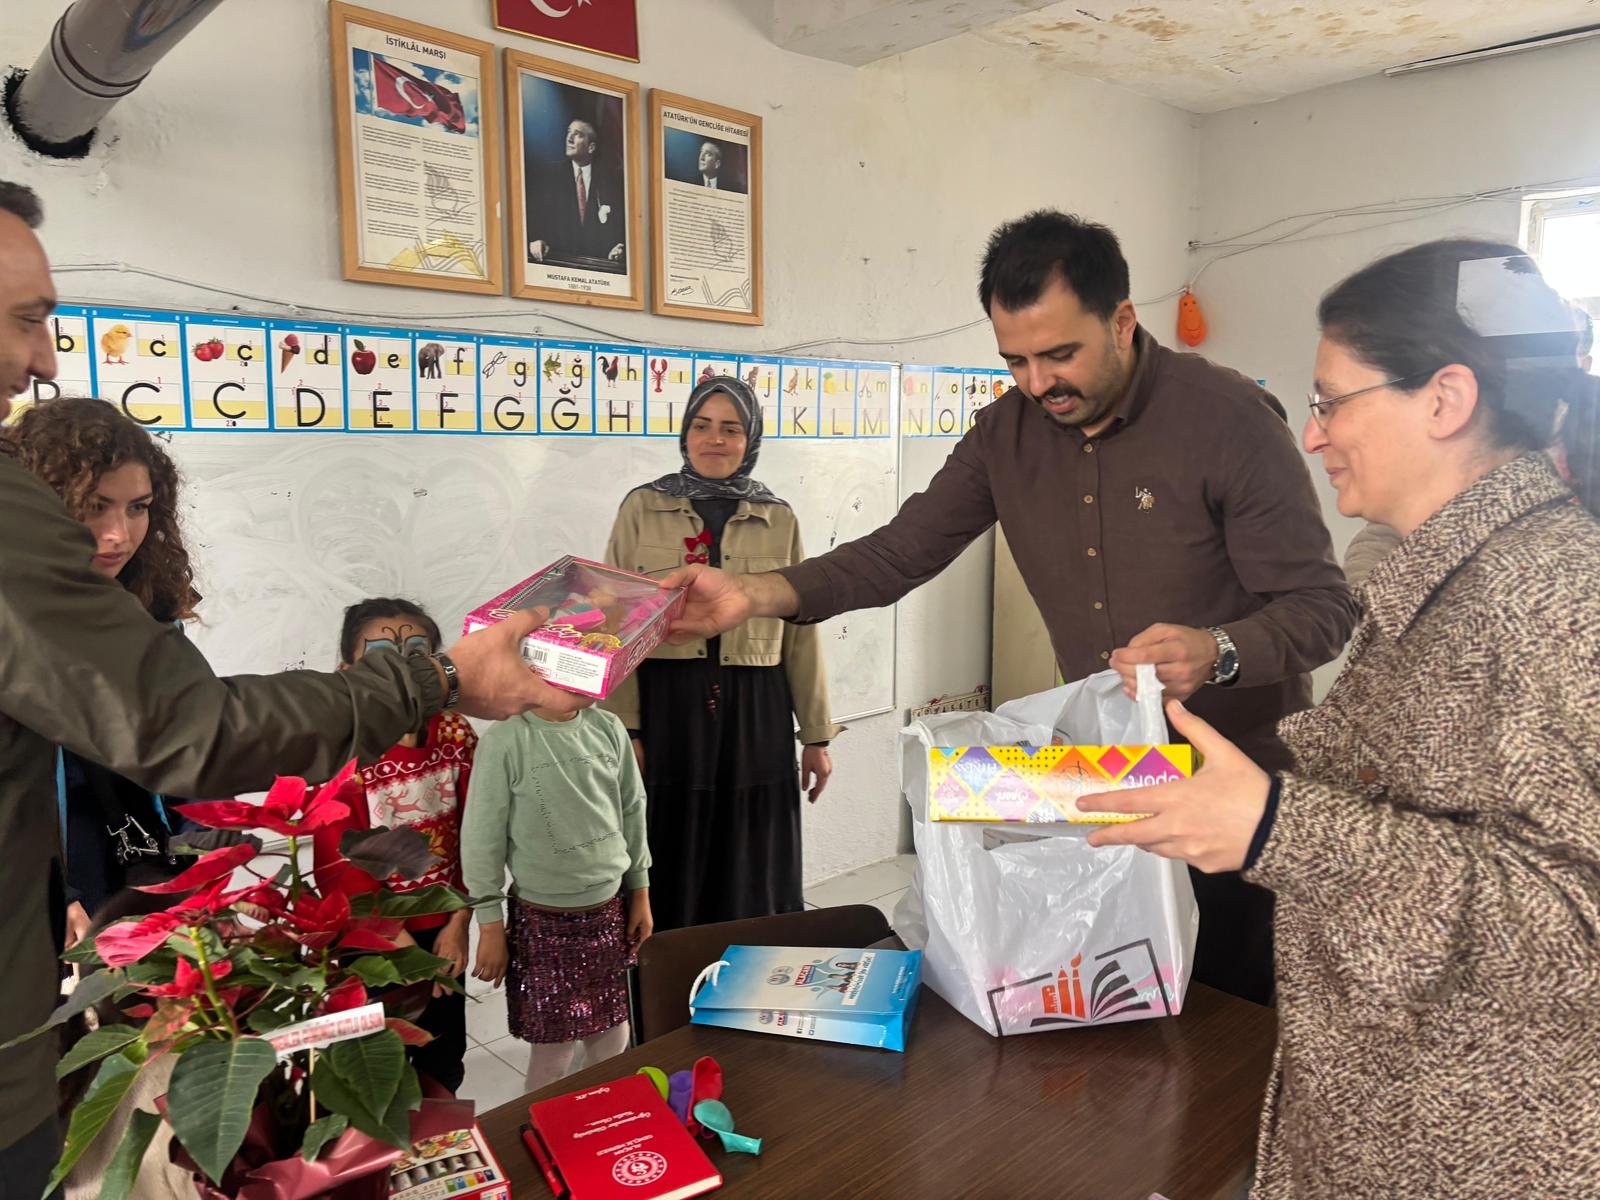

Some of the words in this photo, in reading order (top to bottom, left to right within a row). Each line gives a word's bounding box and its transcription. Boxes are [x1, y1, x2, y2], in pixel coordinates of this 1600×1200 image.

[386, 35, 421, 53] İSTİKLÂL
[422, 46, 447, 60] MARŞI
[664, 111, 697, 125] ATATÜRK'ÜN
[724, 125, 749, 137] HİTABESİ
[547, 273, 570, 282] MUSTAFA
[571, 276, 587, 284] KEMAL
[588, 278, 611, 287] ATATÜRK
[55, 317, 75, 352] b
[150, 340, 166, 357] c
[314, 335, 328, 365] d
[387, 354, 399, 368] e
[453, 348, 465, 375] f
[514, 362, 526, 387] g
[571, 357, 583, 388] ğ
[627, 356, 637, 380] h
[764, 371, 773, 398] j
[806, 368, 812, 390] k
[876, 381, 887, 393] m
[980, 380, 987, 394] ö
[121, 382, 162, 424] C
[297, 388, 326, 428] D
[373, 391, 393, 428] E
[440, 393, 458, 428] F
[494, 396, 525, 431] G
[551, 387, 579, 431] Ğ
[609, 400, 630, 432] H
[794, 406, 807, 435] K
[832, 408, 844, 435] L
[864, 409, 883, 434] M
[909, 408, 923, 433] N
[939, 408, 955, 433] O
